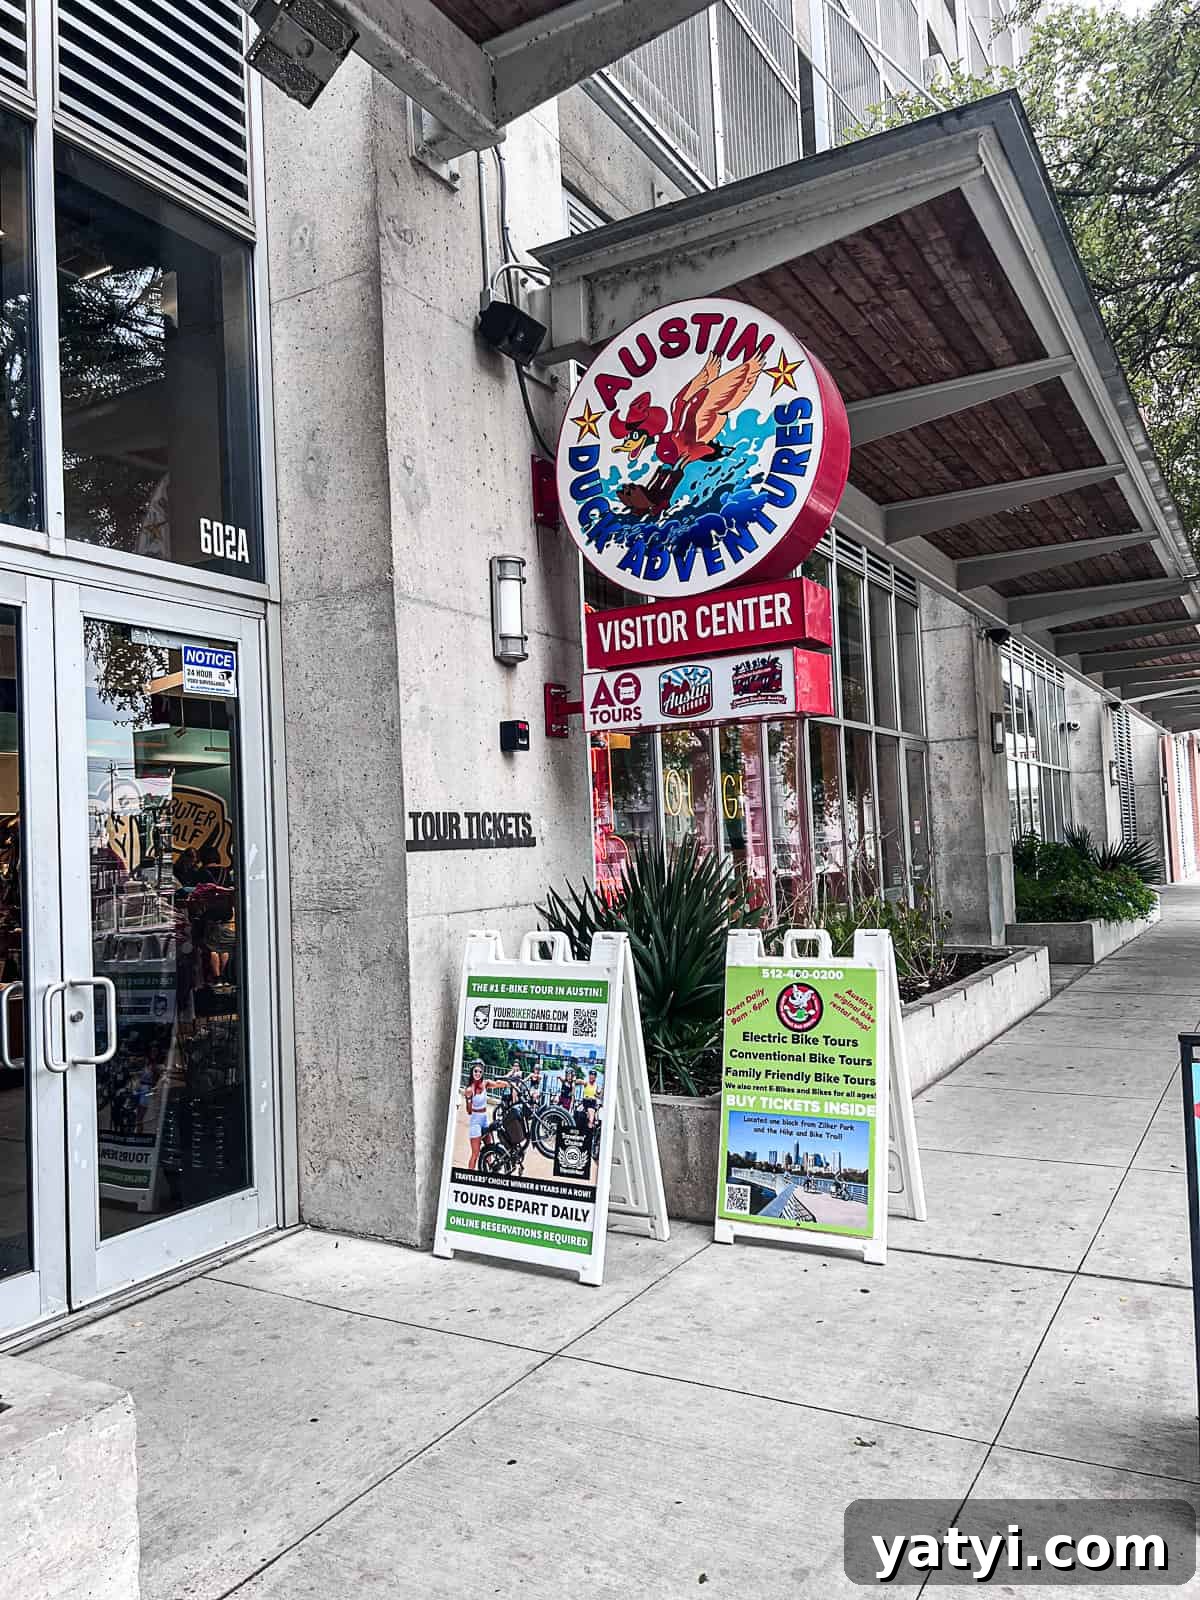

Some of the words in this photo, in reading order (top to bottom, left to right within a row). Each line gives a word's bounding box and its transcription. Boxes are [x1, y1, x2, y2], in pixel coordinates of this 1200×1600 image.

[594, 313, 775, 411] AUSTIN
[568, 444, 614, 553] DUCK
[616, 397, 813, 582] ADVENTURES
[200, 517, 250, 564] 602A
[598, 609, 689, 654] VISITOR
[696, 592, 793, 639] CENTER
[186, 649, 233, 667] NOTICE
[196, 669, 213, 680] HOUR
[663, 684, 710, 713] Austin
[590, 706, 642, 725] TOURS
[170, 821, 204, 844] ALF
[408, 811, 461, 841] TOUR
[464, 812, 533, 839] TICKETS
[472, 983, 488, 993] THE
[489, 984, 499, 993] #1
[500, 984, 529, 994] E-BIKE
[530, 985, 554, 996] TOUR
[555, 987, 565, 996] IN
[565, 988, 603, 998] AUSTIN!
[726, 1001, 745, 1016] Open
[745, 987, 764, 1003] Daily
[845, 989, 873, 1011] Austin's
[494, 1006, 569, 1021] YOURBIKERGANG.COM
[731, 1012, 748, 1025] 9am
[829, 1000, 851, 1017] rental
[834, 993, 862, 1012] original
[860, 1010, 876, 1024] bike
[743, 1032, 788, 1044] Electric
[791, 1034, 820, 1046] Bike
[823, 1035, 859, 1048] Tours
[729, 1049, 806, 1063] Conventional
[809, 1053, 836, 1065] Bike
[838, 1054, 873, 1067] Tours
[725, 1067, 762, 1081] Family
[765, 1069, 811, 1084] Friendly
[814, 1072, 840, 1085] Bike
[843, 1074, 877, 1087] Tours
[725, 1081, 736, 1090] We
[752, 1084, 768, 1092] rent
[795, 1087, 810, 1095] and
[811, 1088, 832, 1096] Bikes
[833, 1090, 845, 1098] for
[726, 1094, 758, 1107] BUY
[760, 1096, 821, 1113] TICKETS
[824, 1101, 876, 1117] INSIDE
[743, 1115, 768, 1123] Located
[801, 1120, 816, 1128] from
[839, 1123, 855, 1131] Park
[488, 1177, 510, 1187] CHOICE
[540, 1184, 559, 1193] YEARS
[568, 1188, 573, 1196] A
[453, 1190, 496, 1208] TOURS
[497, 1196, 548, 1217] DEPART
[551, 1204, 590, 1223] DAILY
[449, 1216, 480, 1229] ONLINE
[480, 1220, 543, 1240] RESERVATIONS
[543, 1231, 588, 1248] REQUIRED
